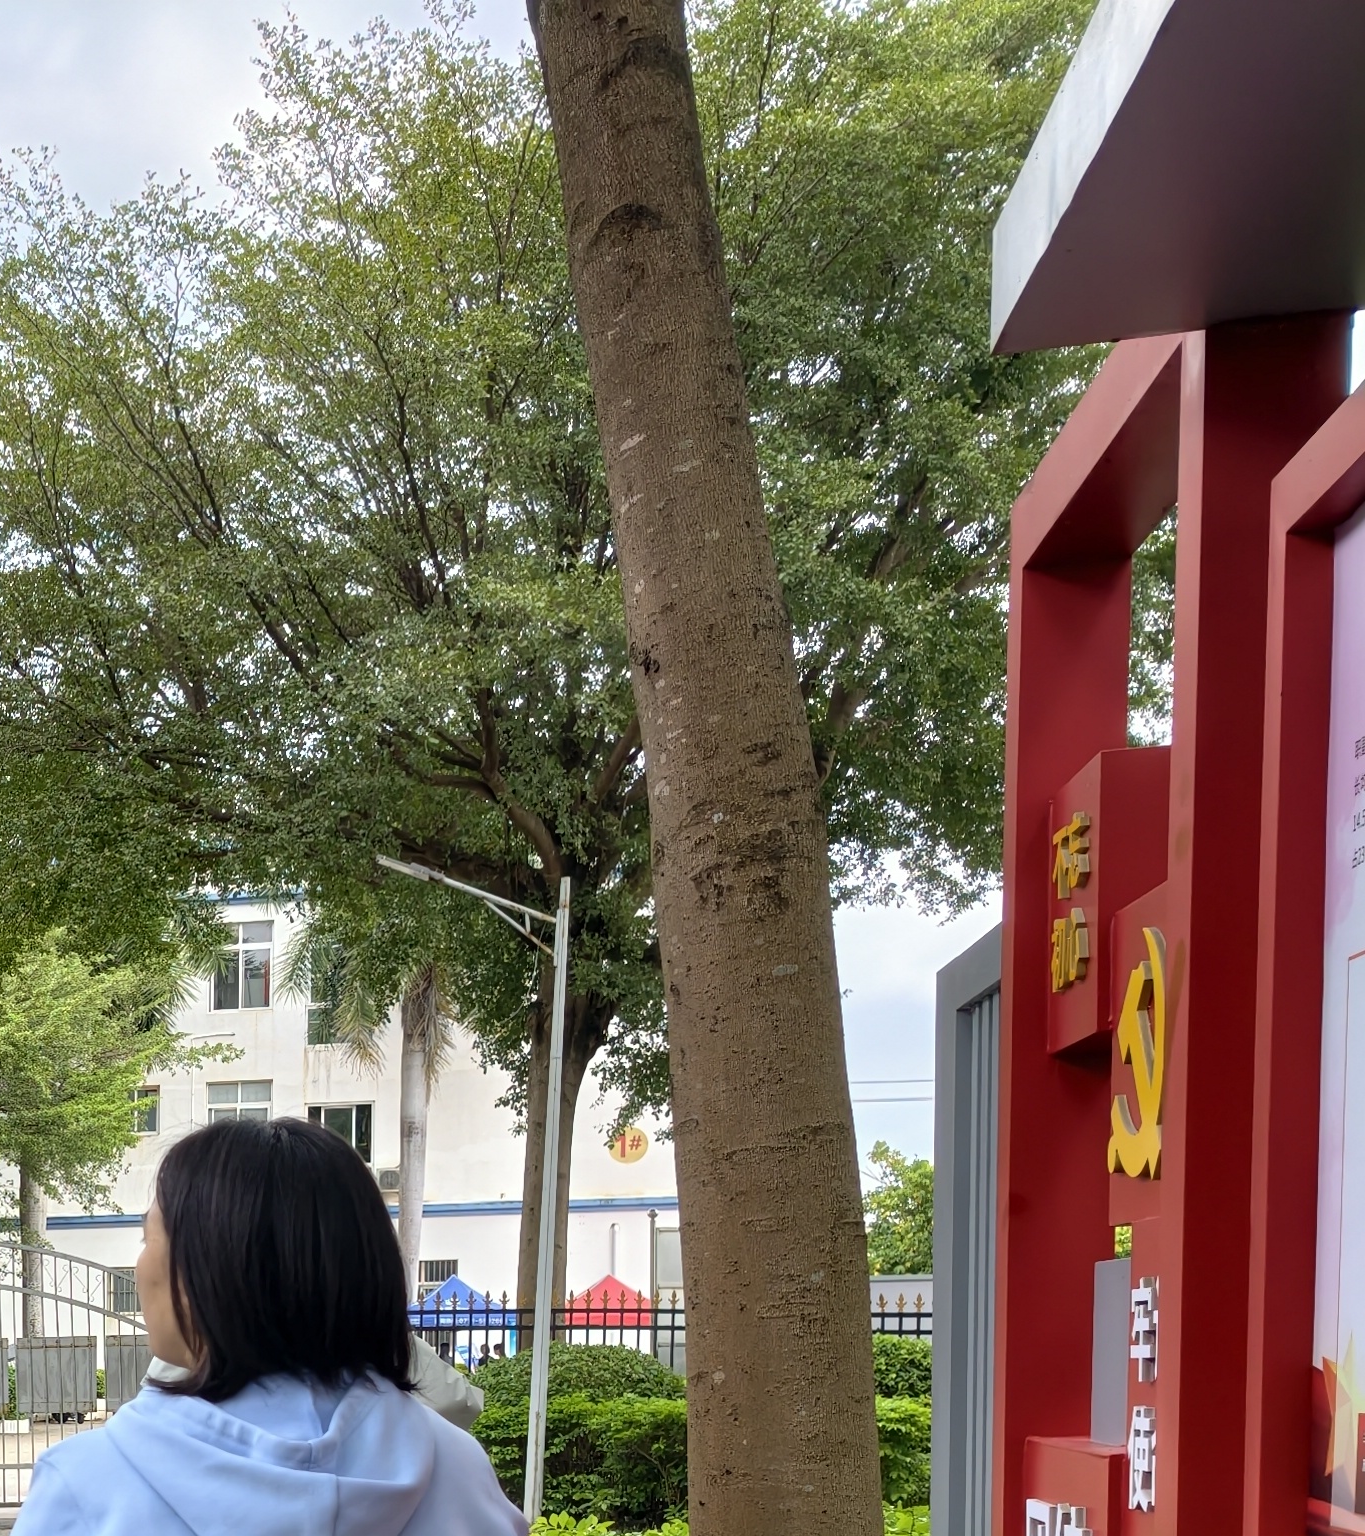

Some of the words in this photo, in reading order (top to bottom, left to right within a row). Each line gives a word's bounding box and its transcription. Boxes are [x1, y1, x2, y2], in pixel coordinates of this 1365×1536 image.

[1053, 812, 1091, 899] 不忘
[1051, 908, 1090, 993] 初心
[1130, 1276, 1159, 1382] 牢
[1128, 1405, 1156, 1512] 使
